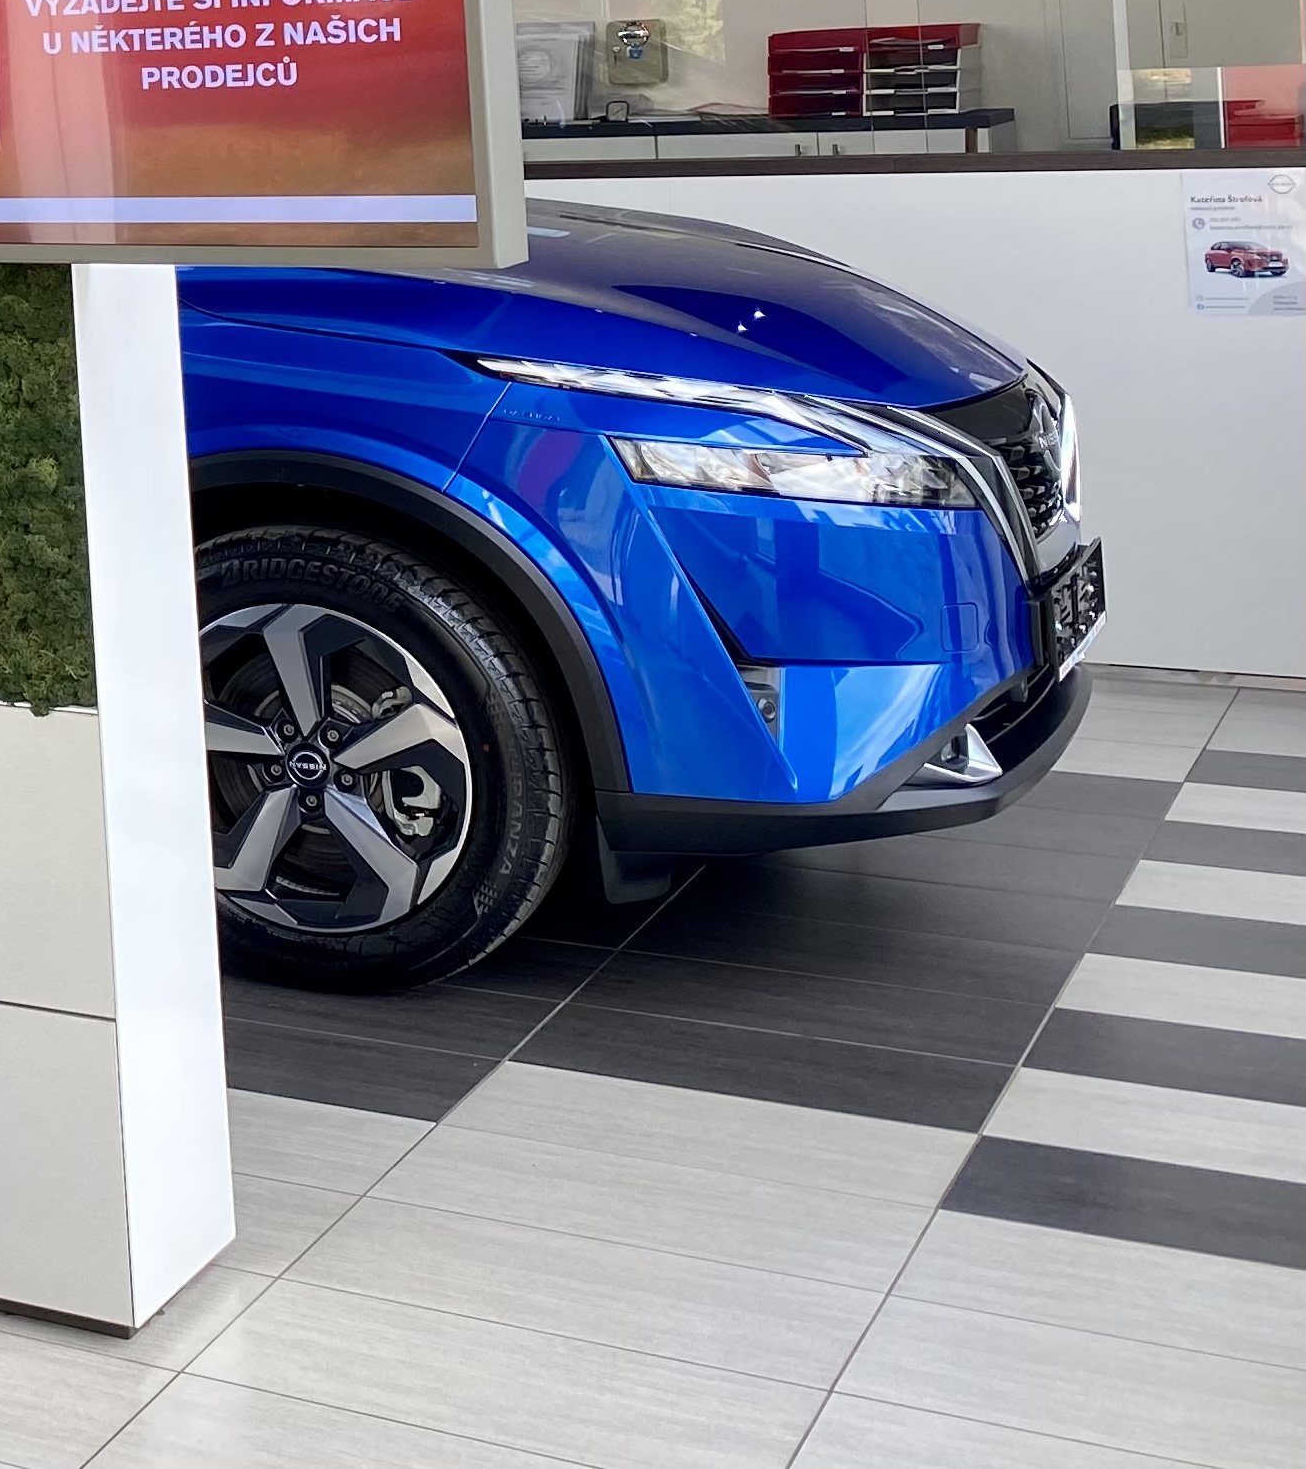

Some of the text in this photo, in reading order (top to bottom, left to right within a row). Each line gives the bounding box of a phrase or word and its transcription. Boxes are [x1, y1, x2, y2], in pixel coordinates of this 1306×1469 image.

[42, 15, 401, 55] U NĚKTERÉHO Z NAŠICH
[141, 56, 298, 90] PRODEJCŮ
